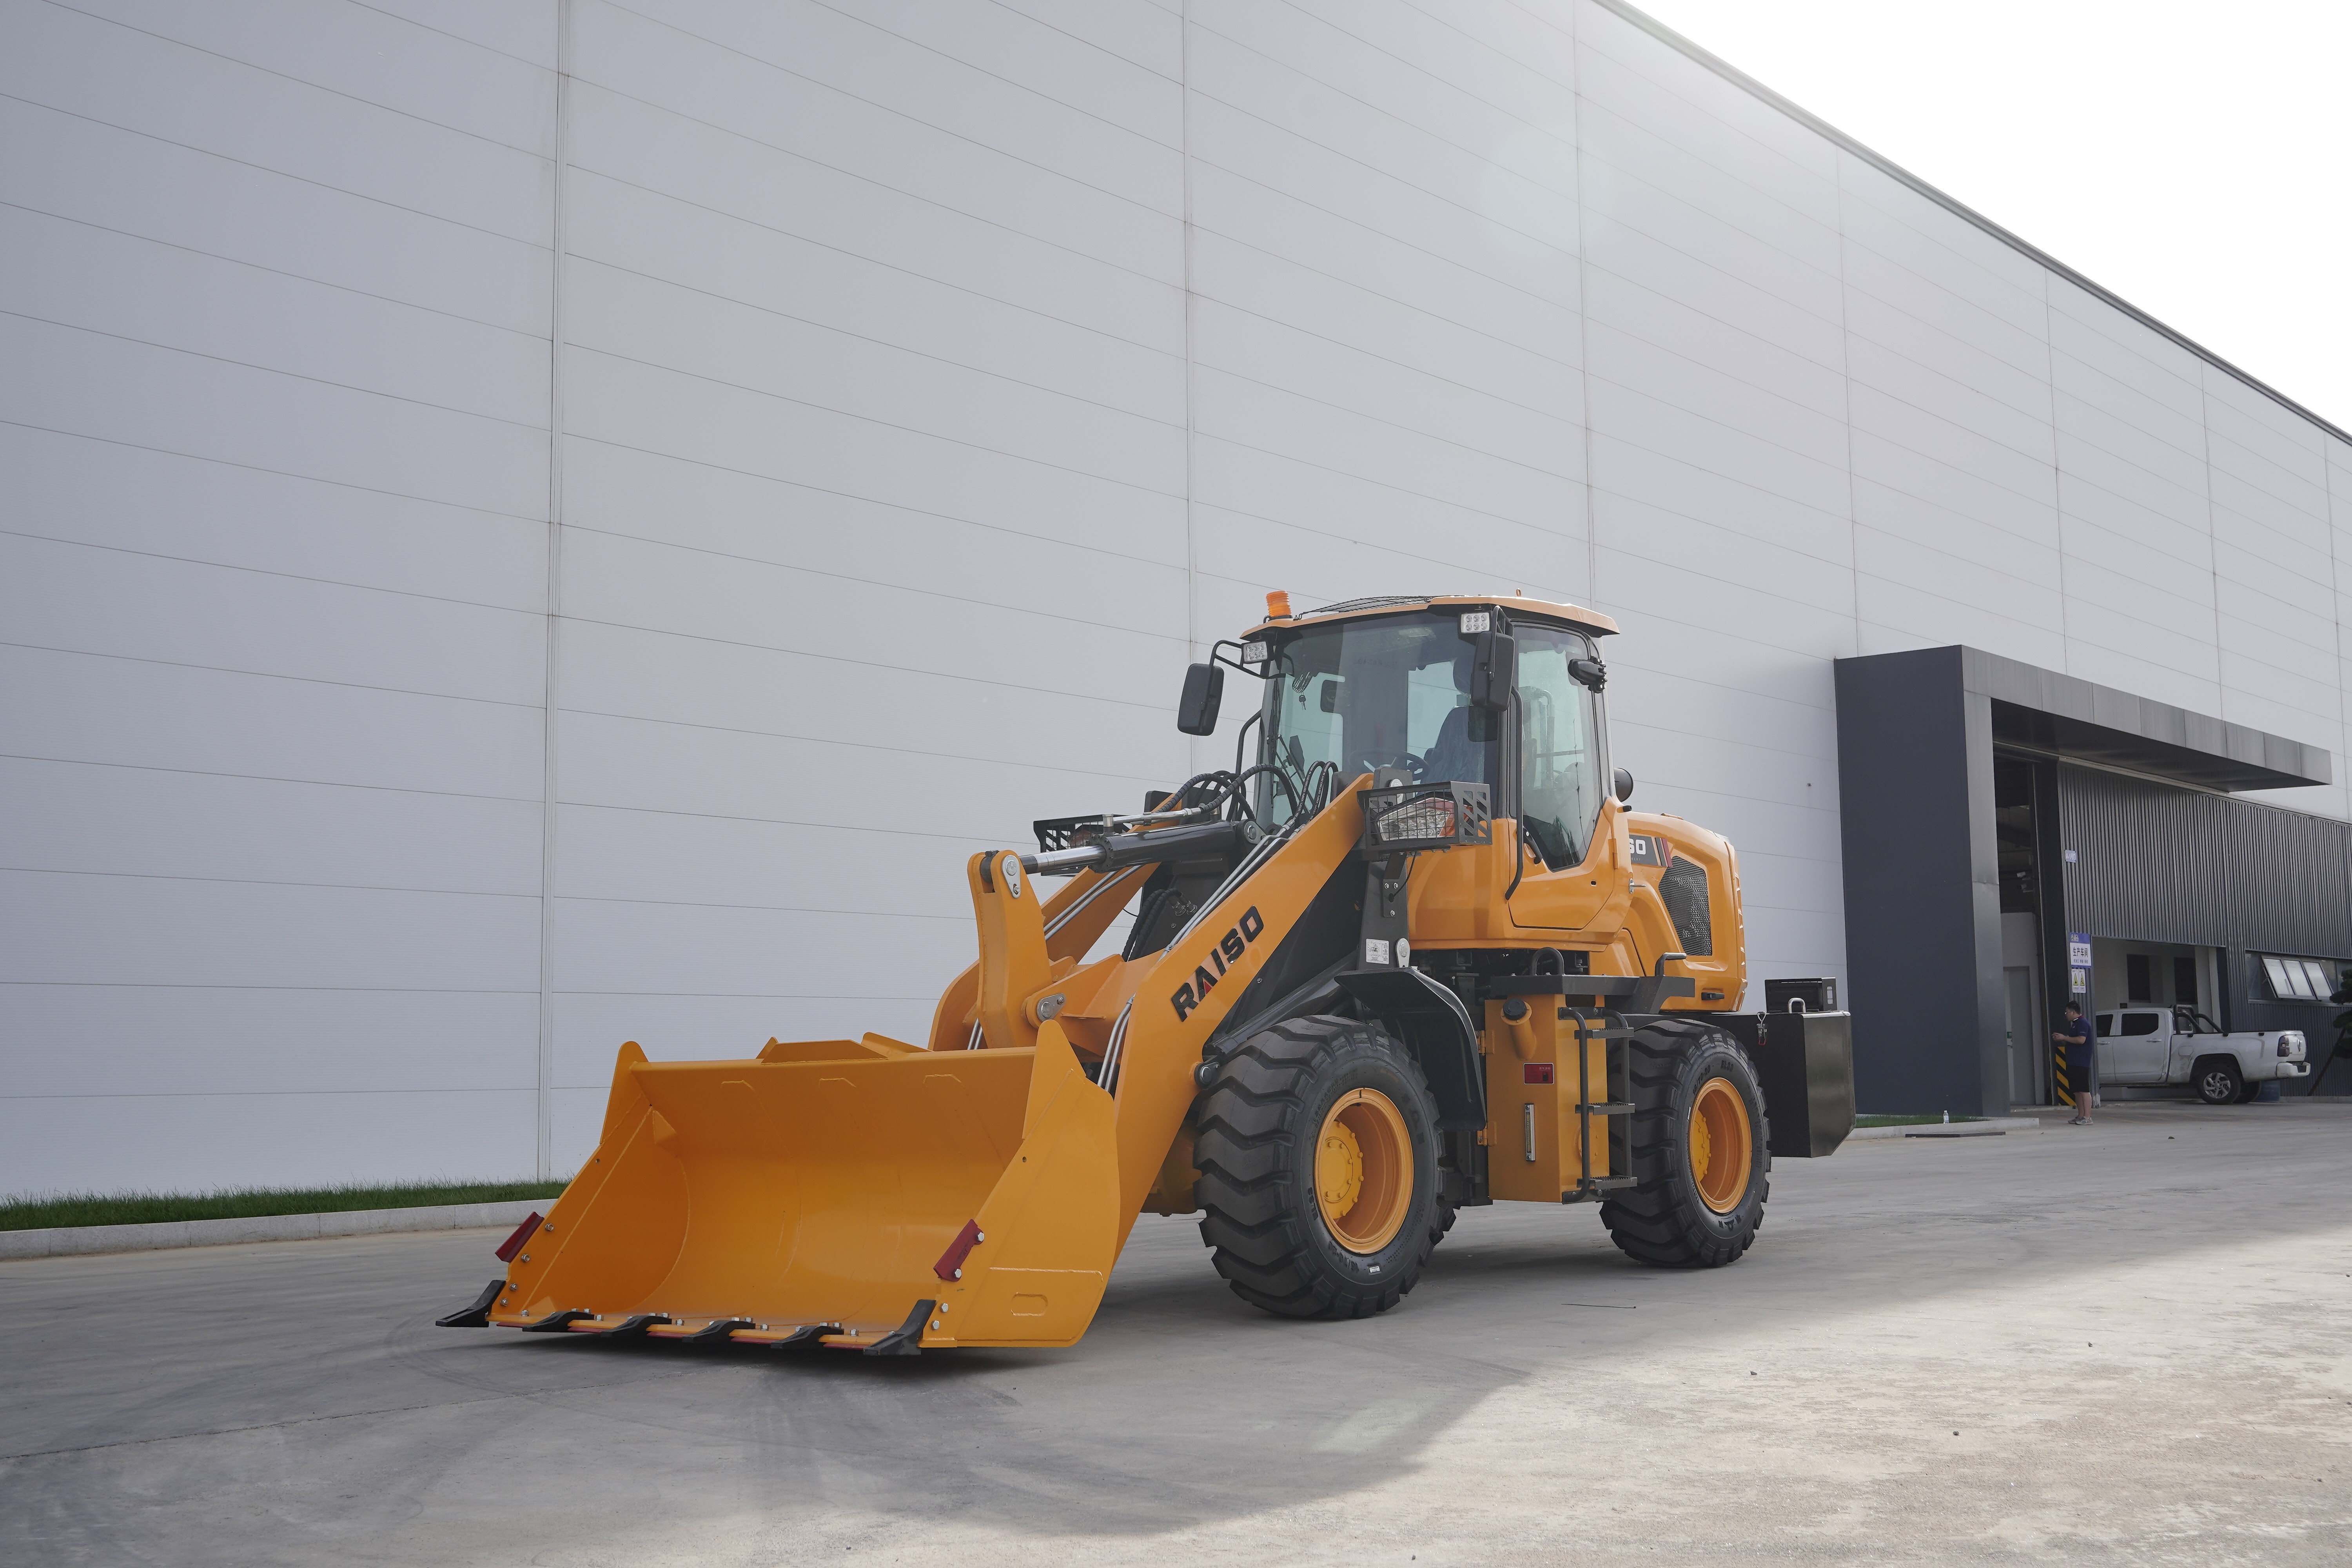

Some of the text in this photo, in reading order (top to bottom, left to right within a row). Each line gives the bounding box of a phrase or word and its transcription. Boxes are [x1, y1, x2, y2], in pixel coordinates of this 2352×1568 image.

[1171, 906, 1264, 1022] RAISO
[2073, 946, 2088, 958] 生产车间
